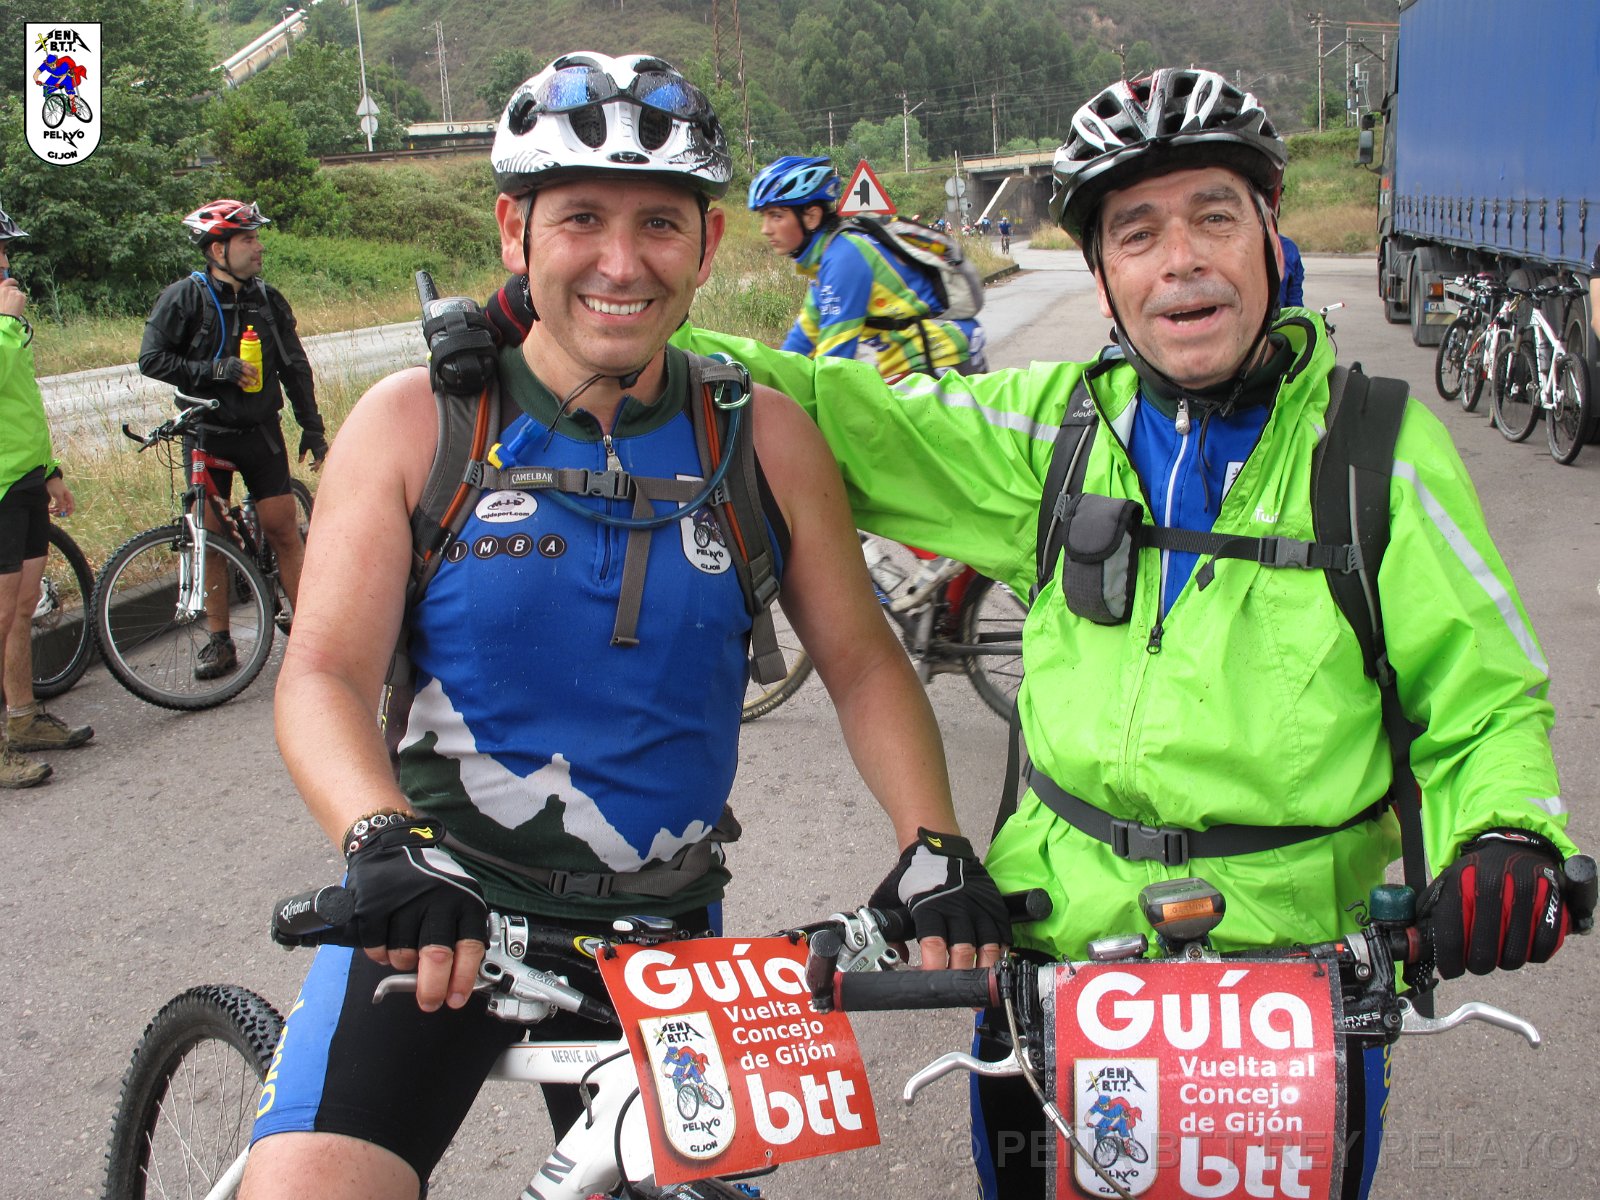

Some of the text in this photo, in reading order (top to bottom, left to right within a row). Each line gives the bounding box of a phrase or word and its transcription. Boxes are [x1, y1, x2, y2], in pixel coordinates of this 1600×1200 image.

[1072, 409, 1097, 418] deute
[511, 472, 553, 484] CAMELBAK
[481, 511, 530, 519] mjdsport.com
[723, 1000, 802, 1023] Vuelta
[1076, 969, 1315, 1051] Guía
[1343, 1011, 1381, 1024] AYES
[732, 1017, 824, 1045] Concejo
[551, 1050, 582, 1063] NERVE
[740, 1039, 836, 1071] de Gijón
[1178, 1054, 1316, 1078] Vuelta al
[745, 1069, 863, 1145] btt
[1179, 1082, 1300, 1110] Concejo
[682, 1116, 721, 1138] PELAYO
[1179, 1109, 1303, 1137] de Gijón
[1094, 1168, 1139, 1185] LAYO
[1179, 1136, 1314, 1199] btt
